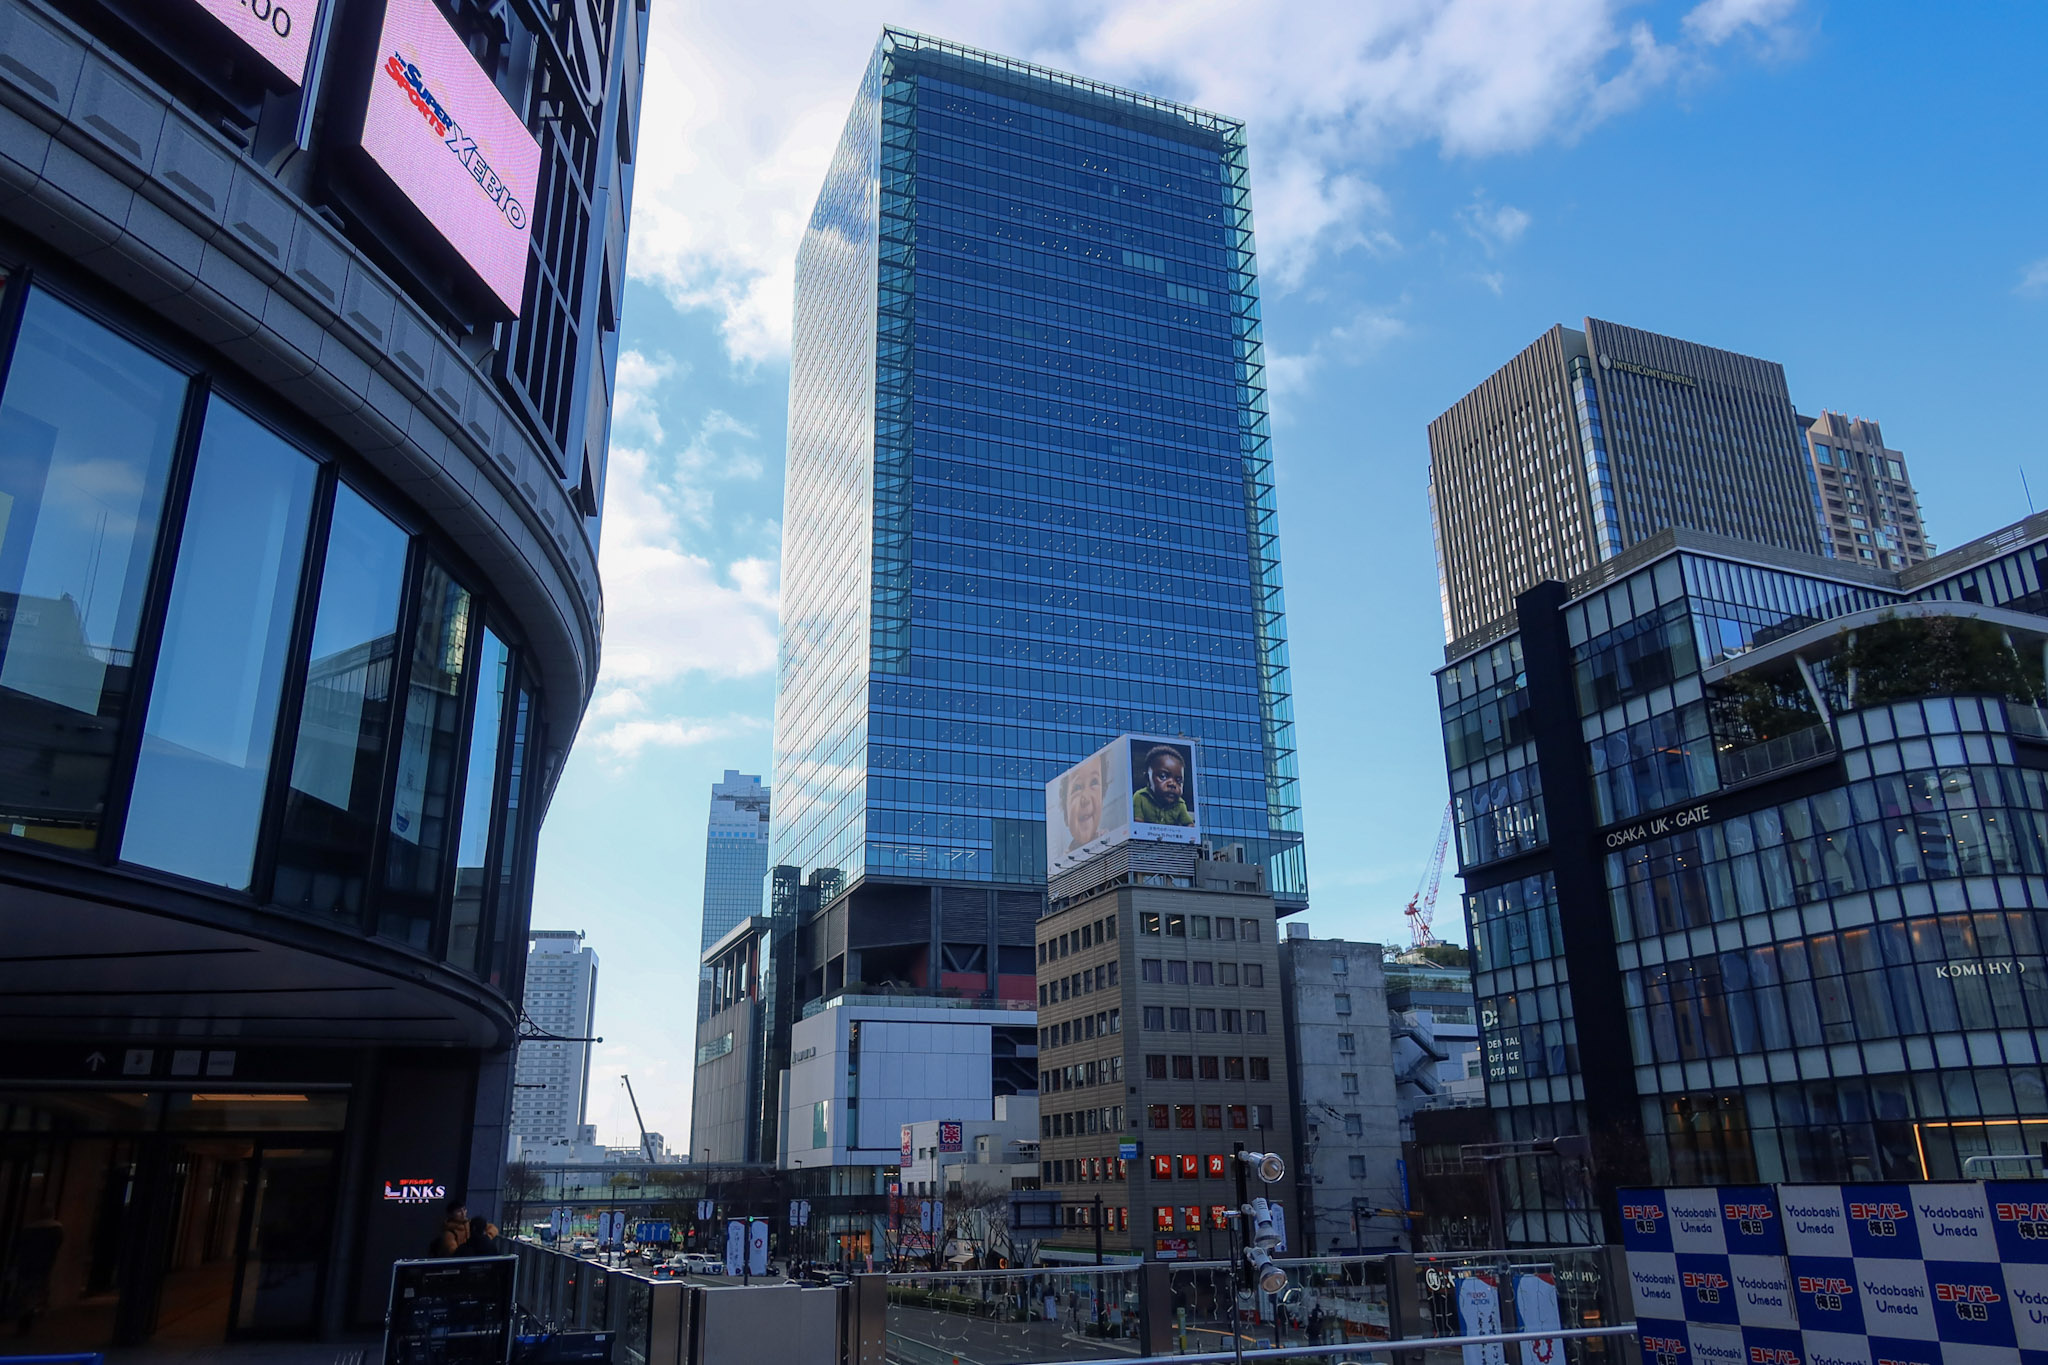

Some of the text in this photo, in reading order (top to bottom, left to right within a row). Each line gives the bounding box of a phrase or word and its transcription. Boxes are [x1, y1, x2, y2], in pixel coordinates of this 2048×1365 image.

[385, 56, 446, 137] SPORTS
[403, 62, 454, 131] SUPER
[446, 122, 527, 231] XEBIO
[1606, 825, 1647, 847] OSAKA
[1487, 1036, 1520, 1049] DENTAL
[1488, 1051, 1519, 1063] OFFICE
[1490, 1064, 1518, 1077] OTANI
[384, 1180, 446, 1199] LINKS
[1623, 1205, 1664, 1219] ヨドバシ
[1671, 1206, 1717, 1218] Yodobashi
[1724, 1204, 1773, 1220] ヨドバシ
[1785, 1205, 1840, 1218] Yodobashi
[1850, 1203, 1908, 1219] ヨドバシ
[1919, 1205, 1984, 1219] Yodobashi
[1680, 1222, 1712, 1233] Umeda
[1740, 1220, 1764, 1235] 梅田
[1796, 1222, 1834, 1234] Umeda
[1868, 1220, 1896, 1236] 梅田
[1932, 1223, 1978, 1237] Umeda
[1632, 1271, 1675, 1284] Yodobashi
[1683, 1272, 1729, 1288] ヨドバシ
[1736, 1276, 1788, 1291] Yodobashi
[1798, 1276, 1853, 1295] ヨドバシ
[1641, 1287, 1671, 1299] Umeda
[1697, 1287, 1720, 1304] 梅田
[1863, 1281, 1924, 1298] Yodobashi
[1936, 1283, 2001, 1303] ヨドバシ
[1747, 1293, 1783, 1307] Umeda
[1815, 1294, 1842, 1312] 梅田
[1875, 1300, 1918, 1315] Umeda
[1955, 1303, 1988, 1321] 梅田
[1643, 1336, 1686, 1354] ヨドバシ
[1693, 1343, 1741, 1359] Yodobashi
[1749, 1346, 1800, 1365] ヨドバシ
